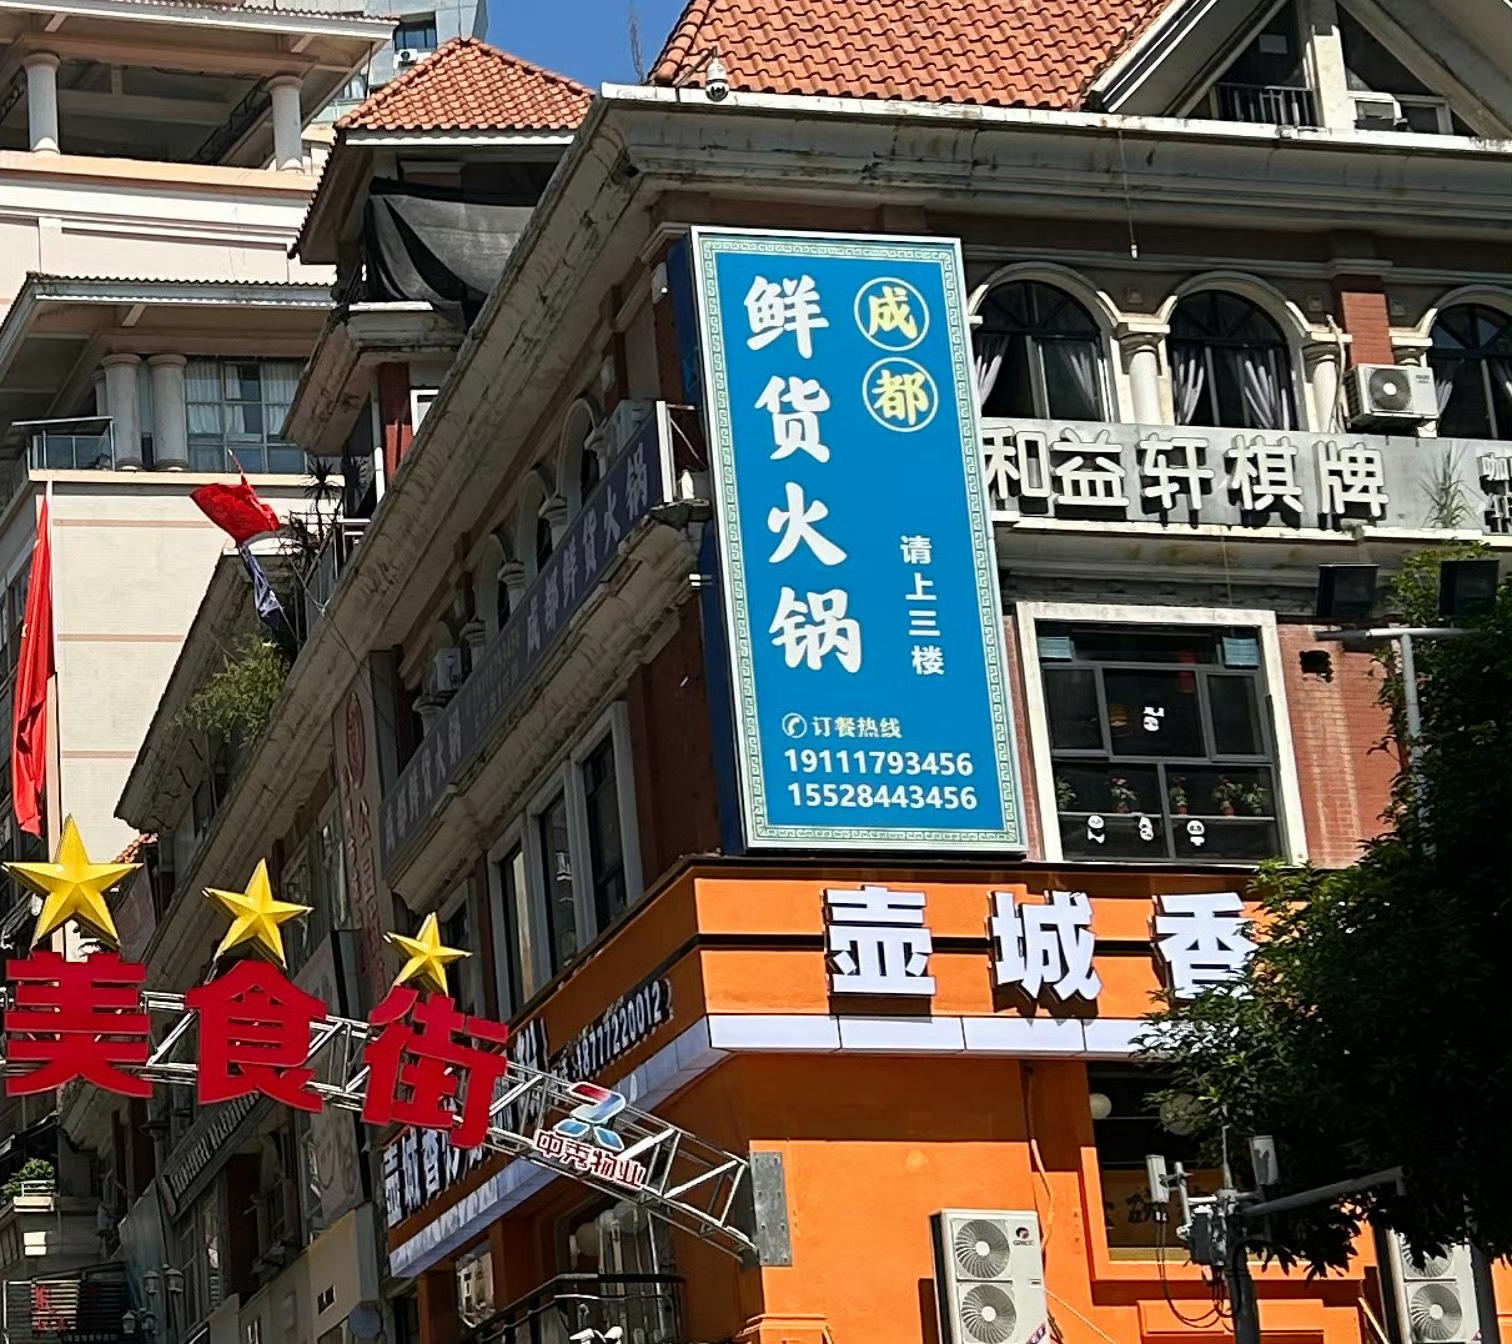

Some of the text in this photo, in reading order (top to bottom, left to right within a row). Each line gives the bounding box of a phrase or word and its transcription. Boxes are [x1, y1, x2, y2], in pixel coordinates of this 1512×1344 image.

[865, 284, 929, 421] 成都
[745, 275, 862, 674] 鲜货火锅
[982, 427, 1390, 518] 和益轩棋牌
[900, 535, 945, 676] 请上三楼
[784, 748, 974, 776] 19111793456
[812, 716, 903, 738] 订餐热线
[787, 782, 978, 810] 15528443456
